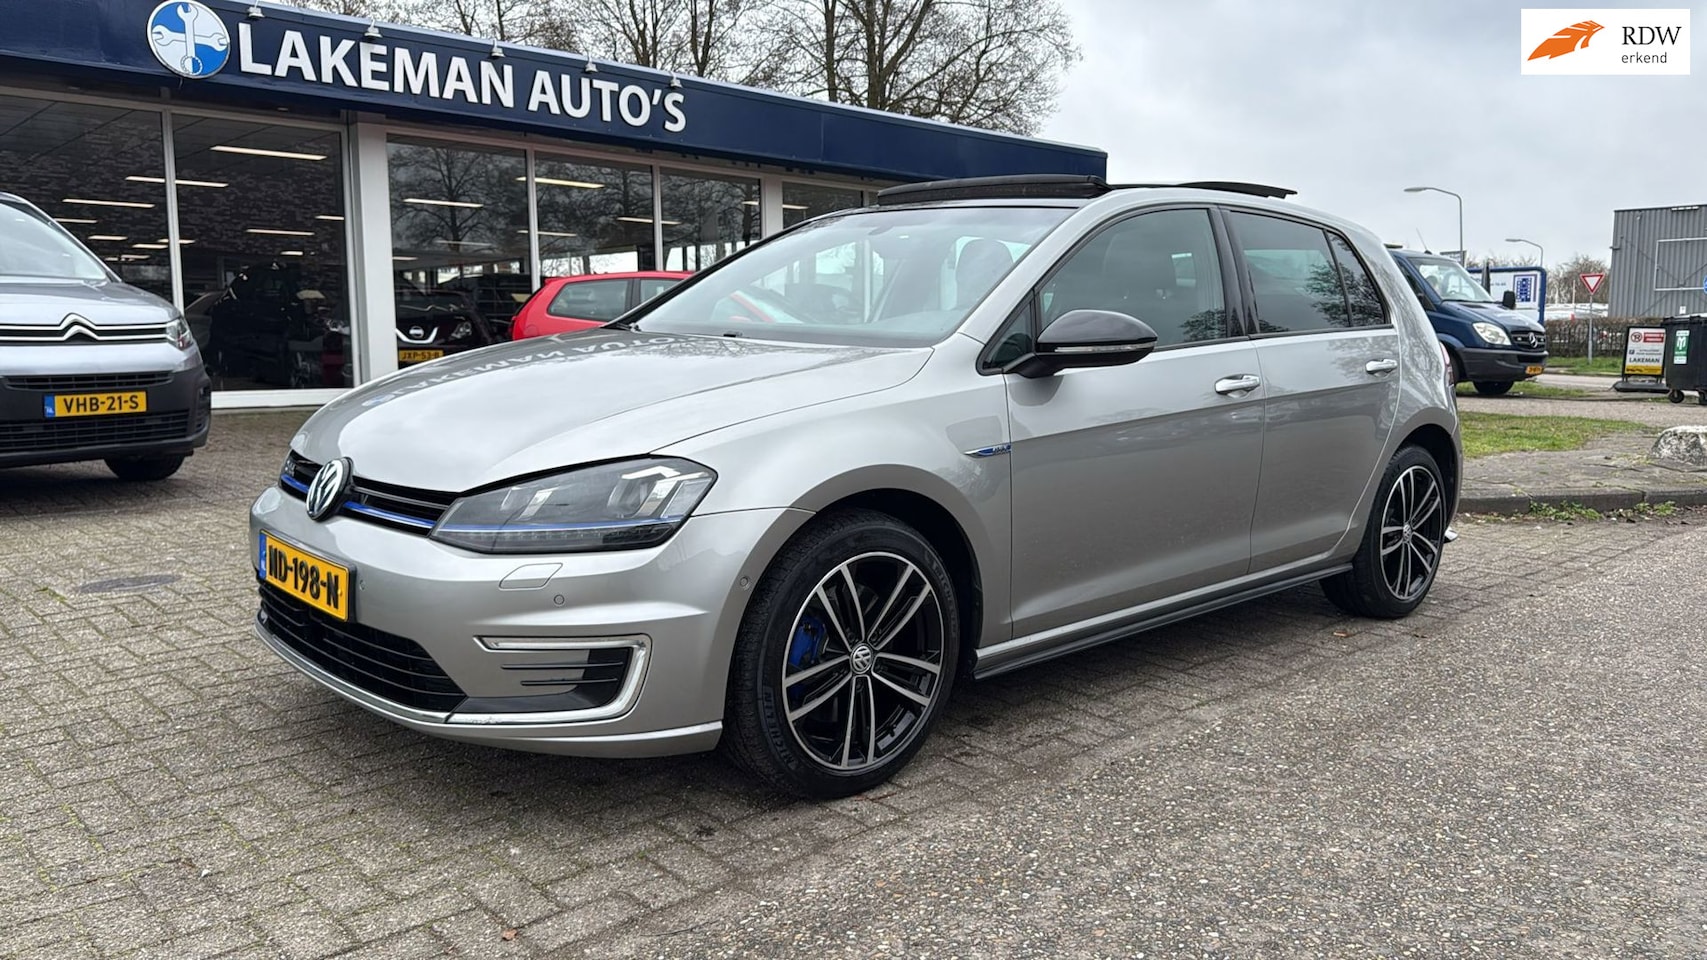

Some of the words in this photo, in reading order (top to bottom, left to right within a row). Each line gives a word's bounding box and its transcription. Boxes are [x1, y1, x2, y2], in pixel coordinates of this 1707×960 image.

[239, 23, 514, 109] LAKEMAN
[528, 70, 687, 133] AUTO'S
[64, 395, 139, 413] VHB-21-S
[268, 545, 339, 610] ND-198-N
